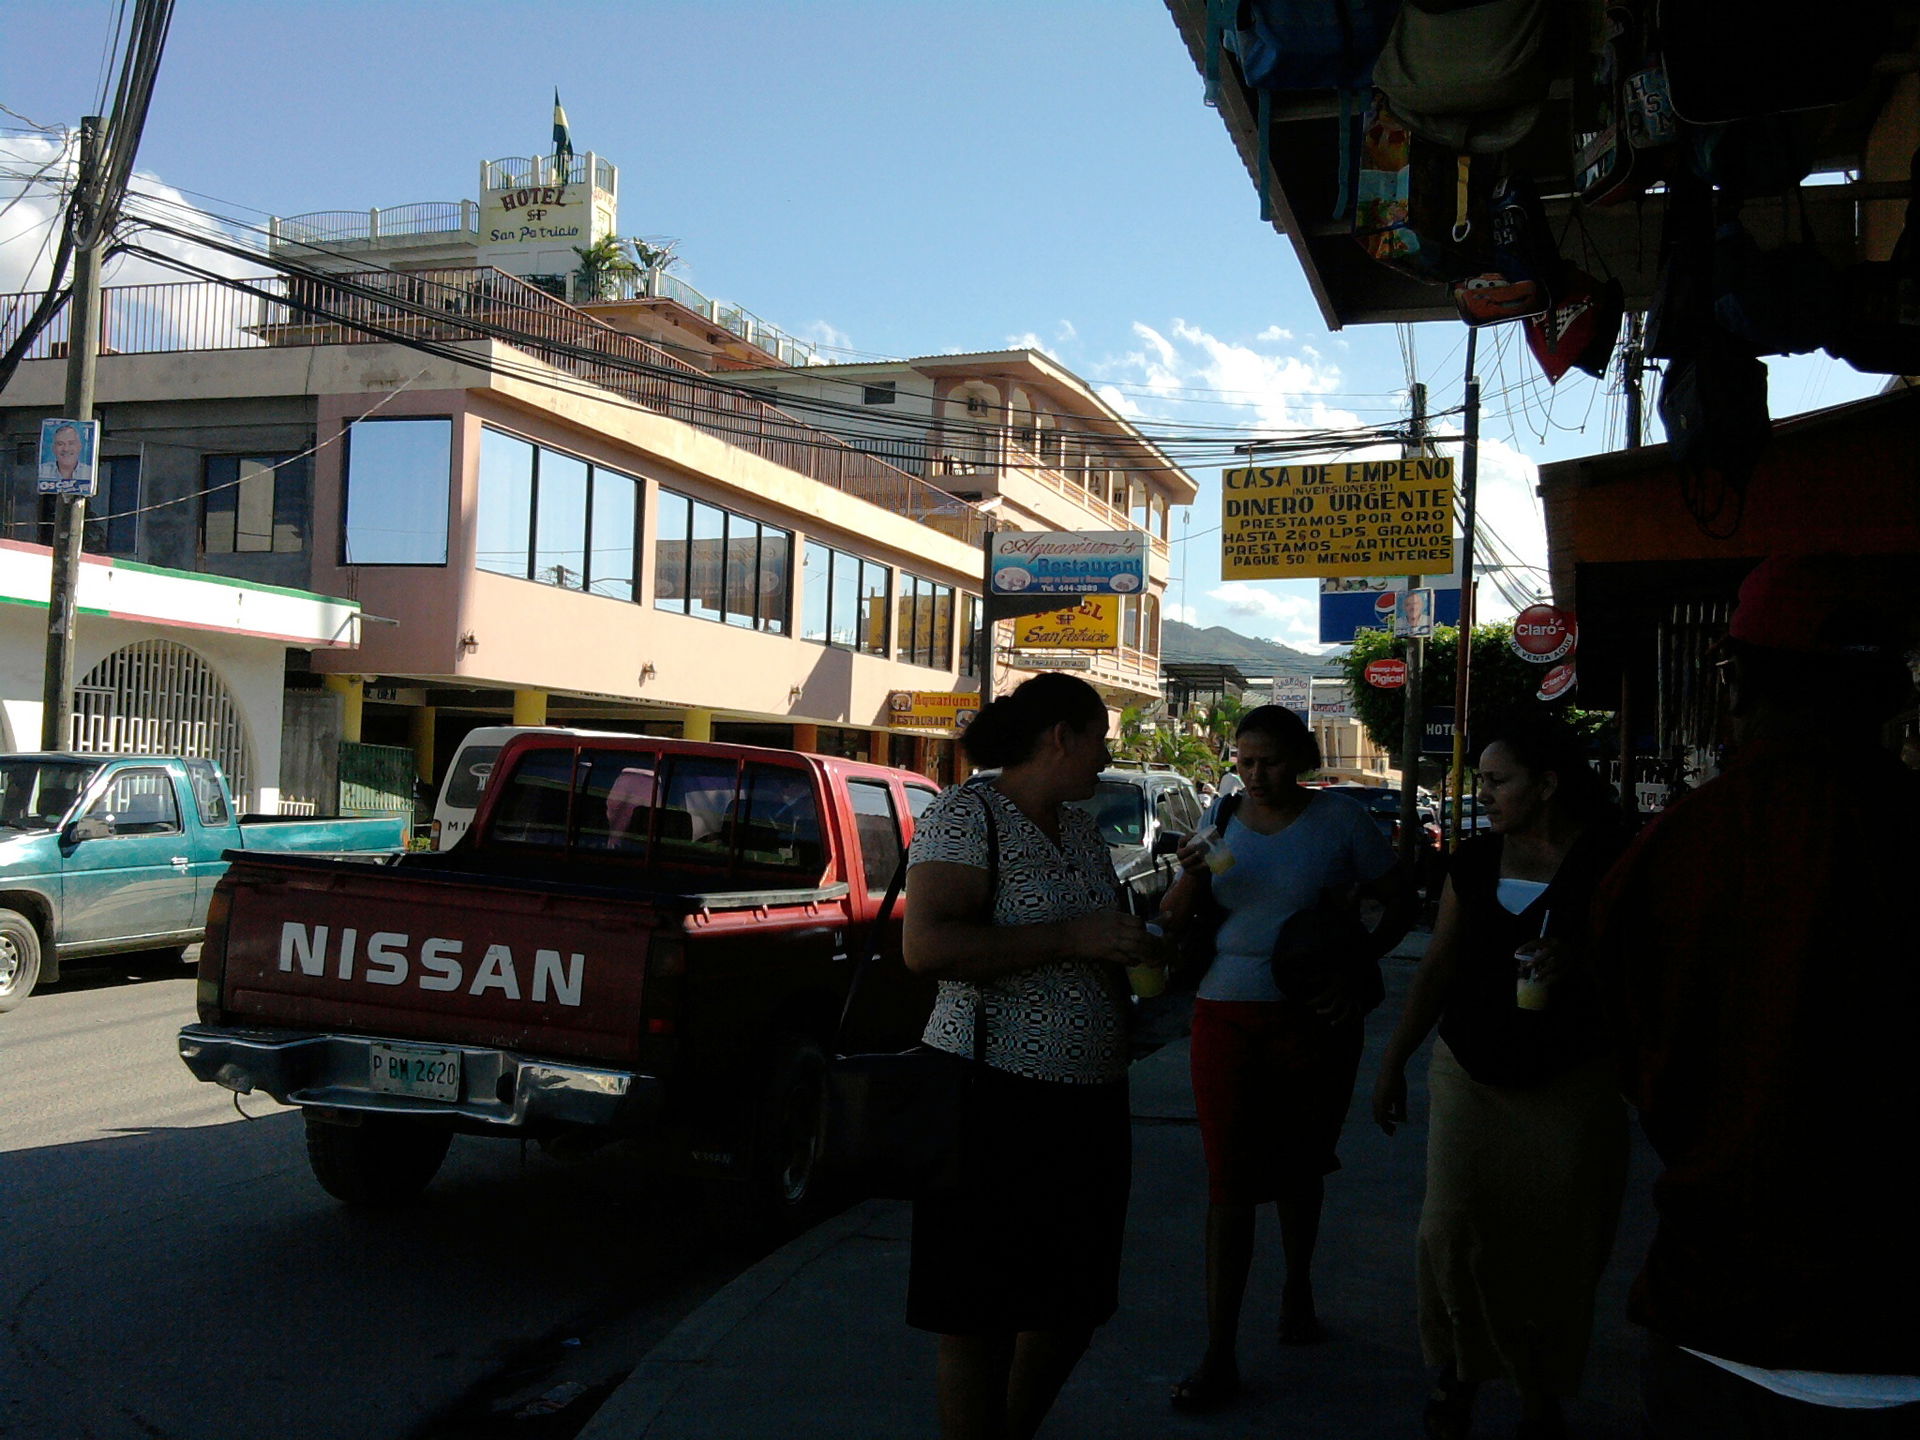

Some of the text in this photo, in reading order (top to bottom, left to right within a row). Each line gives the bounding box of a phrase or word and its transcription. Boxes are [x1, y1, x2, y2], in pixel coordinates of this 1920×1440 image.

[500, 187, 567, 213] HOTEL
[490, 229, 515, 242] San
[1226, 467, 1291, 489] CASA
[1301, 464, 1333, 486] DE
[1292, 484, 1376, 496] INVERSIONES
[1226, 489, 1449, 517] DINERO URGENTE
[1240, 510, 1445, 530] PRESTAMOS POR ORO
[1223, 531, 1277, 544] HASTA
[1378, 523, 1444, 536] GRAMO
[1000, 534, 1137, 564] Aquarium's
[1224, 541, 1332, 556] PRESTAMOS
[1355, 535, 1451, 549] ARTICULOS
[1037, 558, 1141, 573] Restaurant
[1233, 554, 1280, 566] PAGUE
[1317, 551, 1371, 564] MENOS
[1379, 548, 1451, 562] INTERES
[1024, 625, 1059, 643] San
[1370, 673, 1405, 685] Digicel
[1426, 723, 1456, 735] HOTE
[279, 921, 586, 1007] NISSAN
[415, 1059, 457, 1085] 2620
